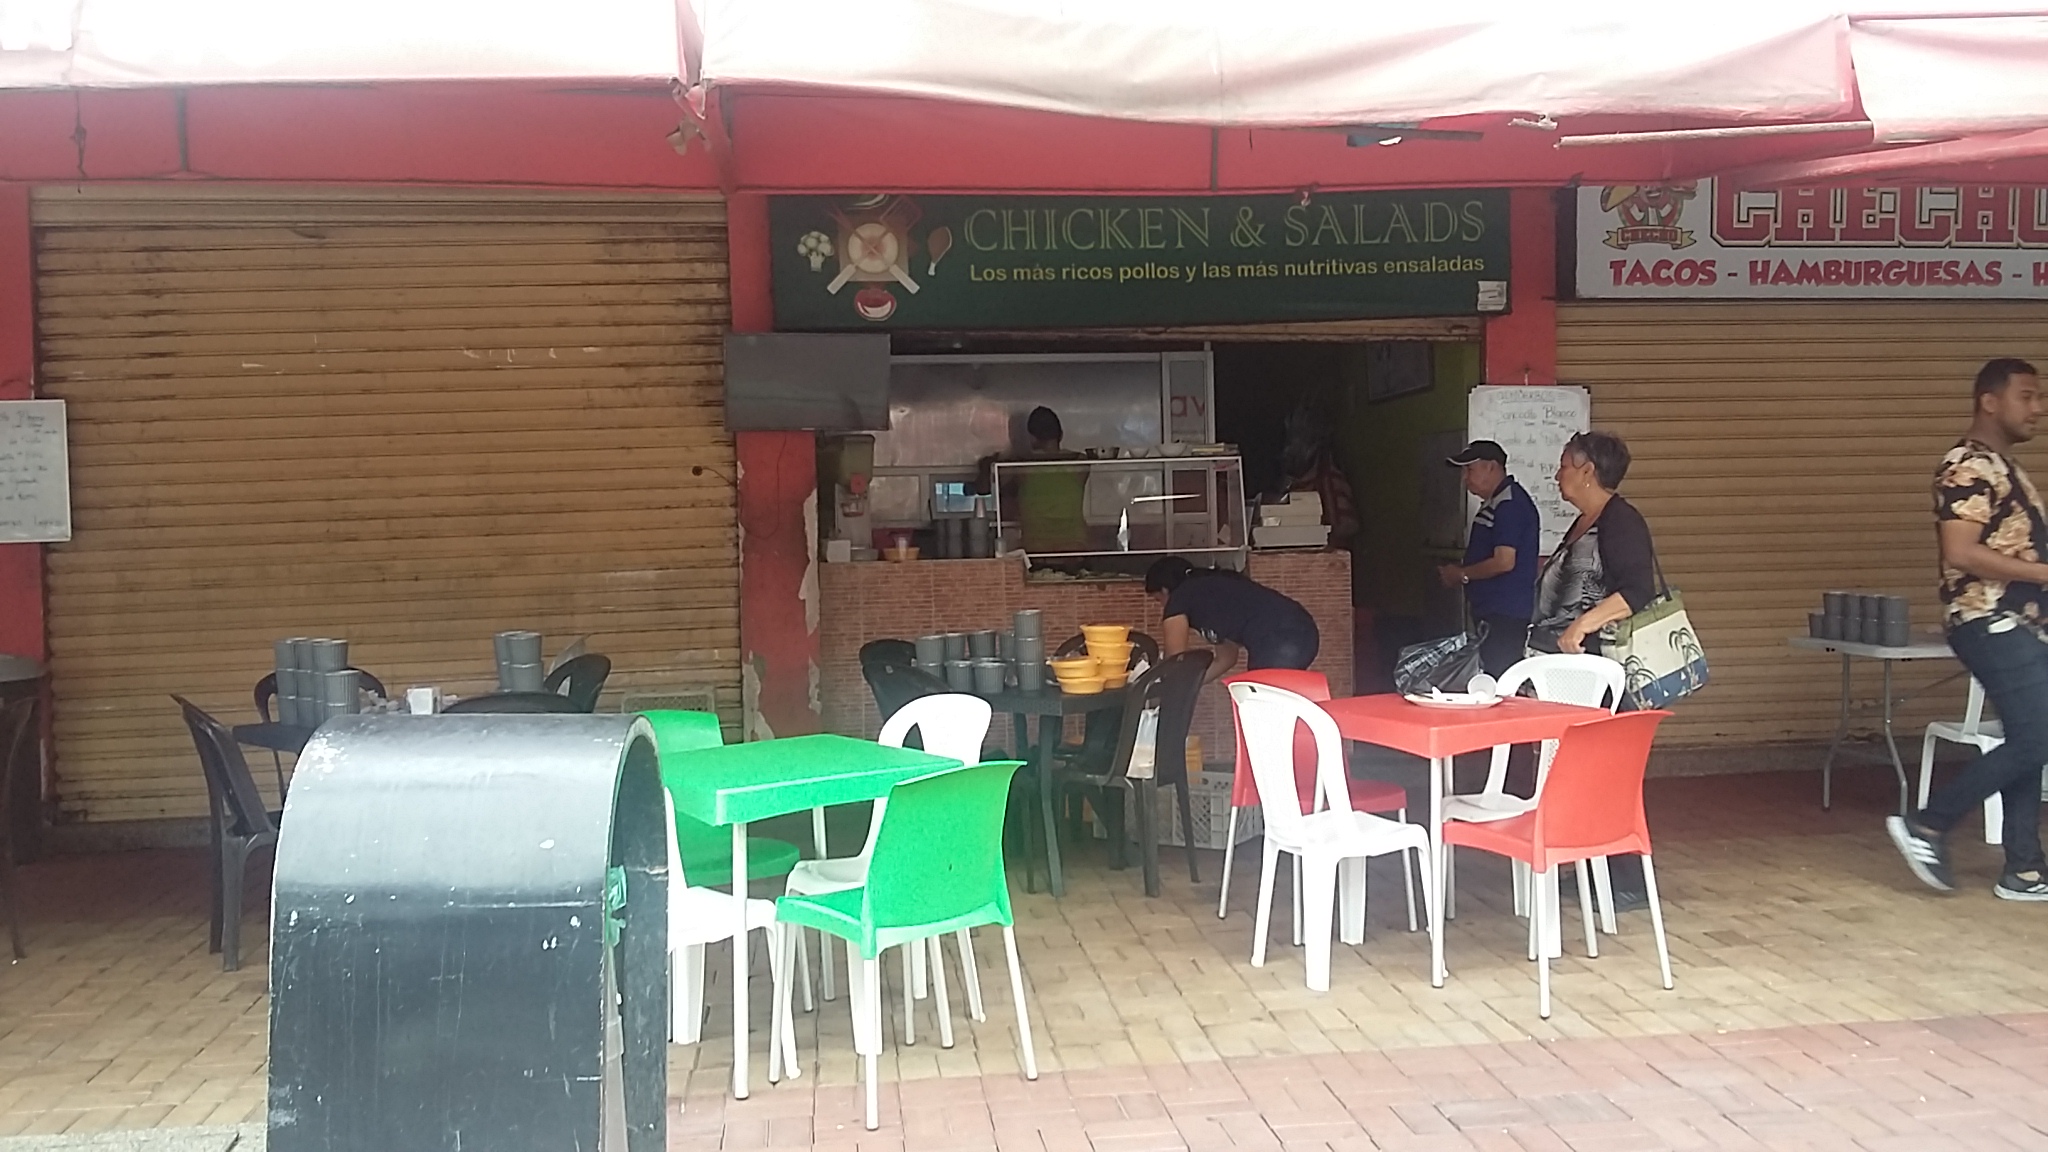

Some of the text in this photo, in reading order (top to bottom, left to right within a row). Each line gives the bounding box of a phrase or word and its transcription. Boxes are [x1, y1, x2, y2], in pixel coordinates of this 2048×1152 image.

[964, 200, 1486, 251] CHICKEN & SALADS
[970, 255, 1485, 283] Los más ricos pollos y las más nutritivas ensaladas
[1609, 259, 1717, 287] TACOS
[1749, 259, 2003, 287] HAMBURGUESAS
